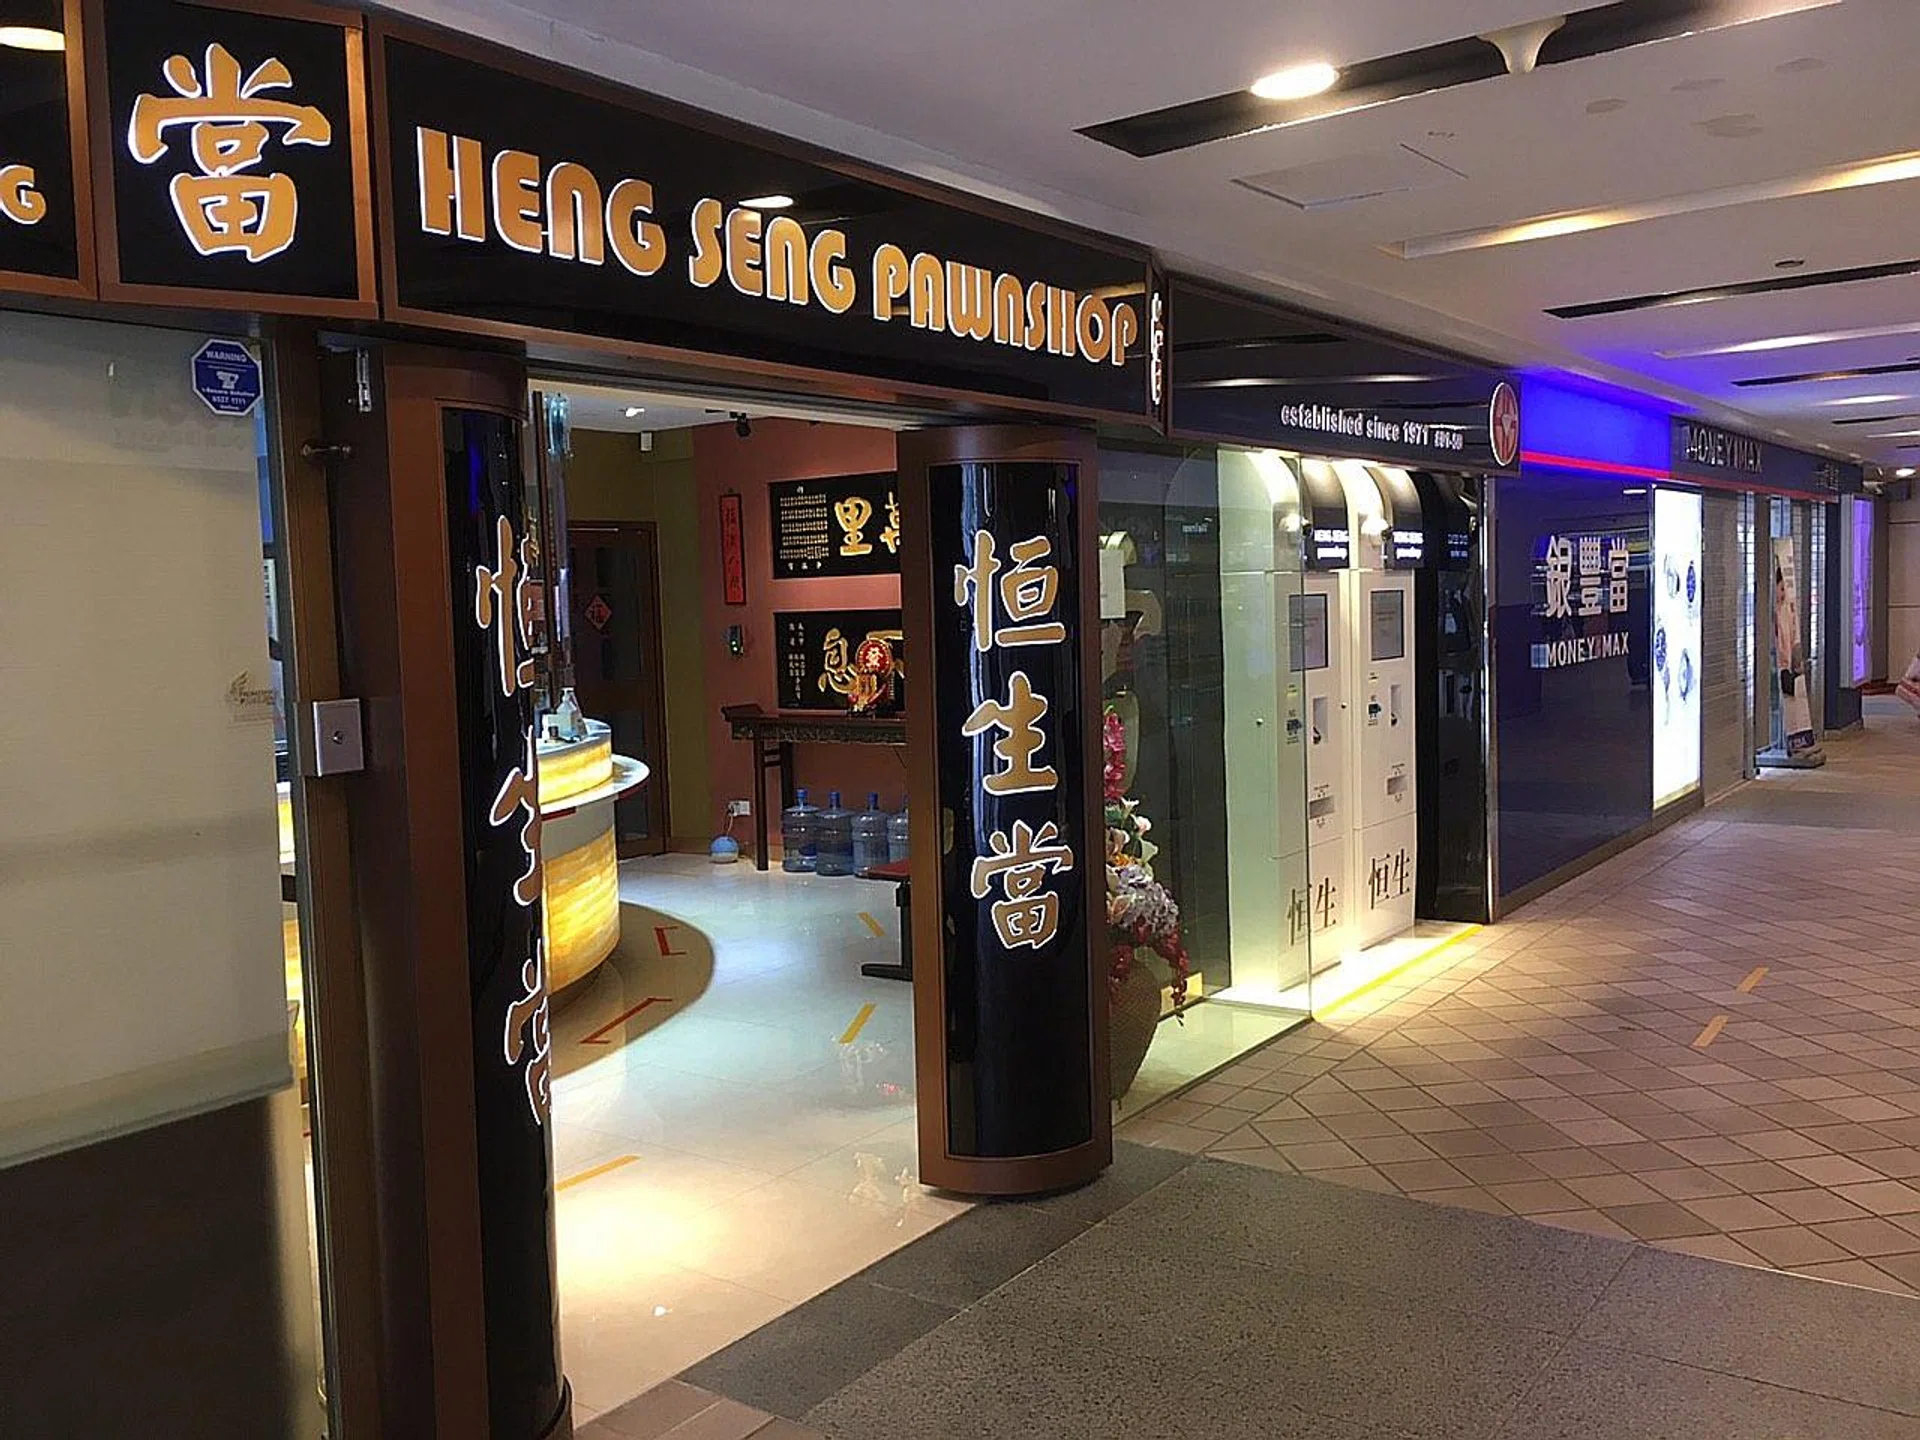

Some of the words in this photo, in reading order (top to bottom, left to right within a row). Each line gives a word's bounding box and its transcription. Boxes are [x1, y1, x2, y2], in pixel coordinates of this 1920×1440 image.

[127, 42, 332, 262] 當
[416, 126, 667, 276] HENG
[688, 197, 856, 313] SENG
[872, 243, 1138, 366] PAWNSHOP
[1281, 404, 1364, 436] established
[1366, 415, 1400, 442] since
[1402, 421, 1429, 446] 1971
[1546, 535, 1629, 618] 銀豐當
[1547, 636, 1595, 668] MONEY
[1602, 631, 1630, 658] MAX
[953, 529, 1073, 950] 恒生當
[1286, 877, 1337, 947] 恒生
[1367, 847, 1411, 911] 恒生
